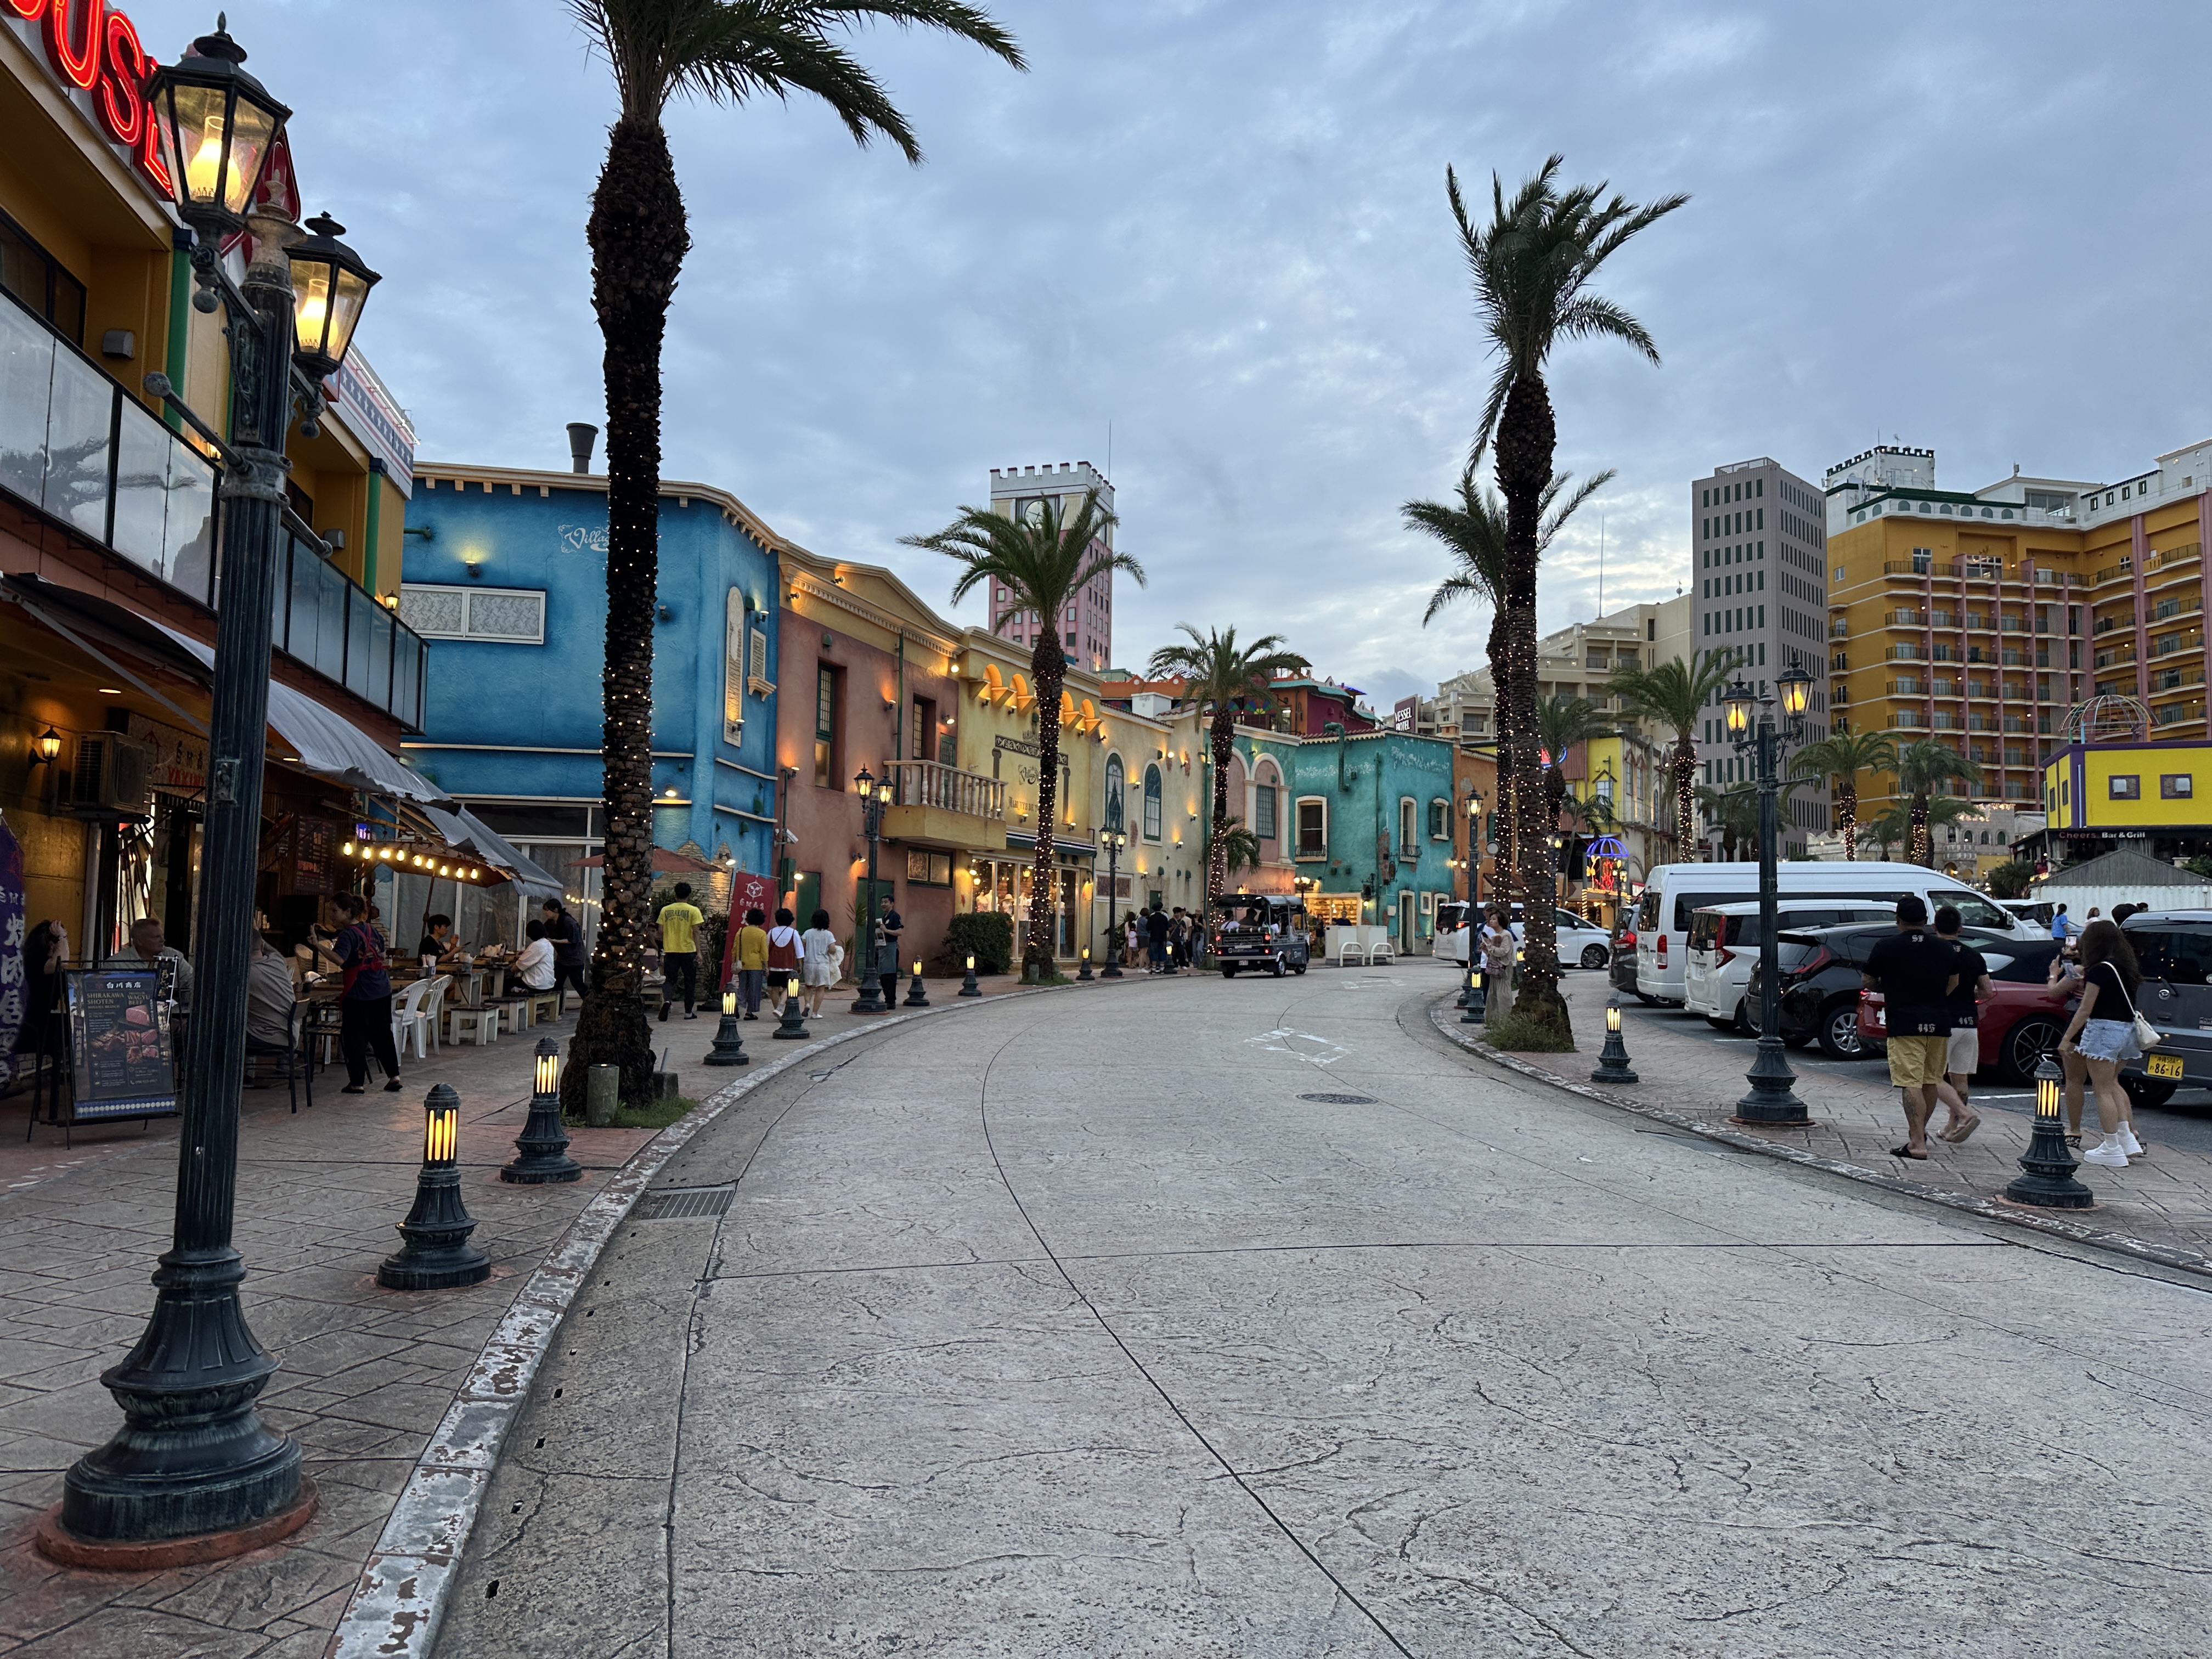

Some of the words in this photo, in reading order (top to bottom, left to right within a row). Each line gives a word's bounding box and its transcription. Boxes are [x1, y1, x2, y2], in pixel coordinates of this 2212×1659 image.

[564, 527, 610, 549] Villag
[1395, 707, 1412, 722] VESSEL
[1396, 720, 1410, 731] HOTEL
[2155, 1063, 2181, 1076] 86-16
